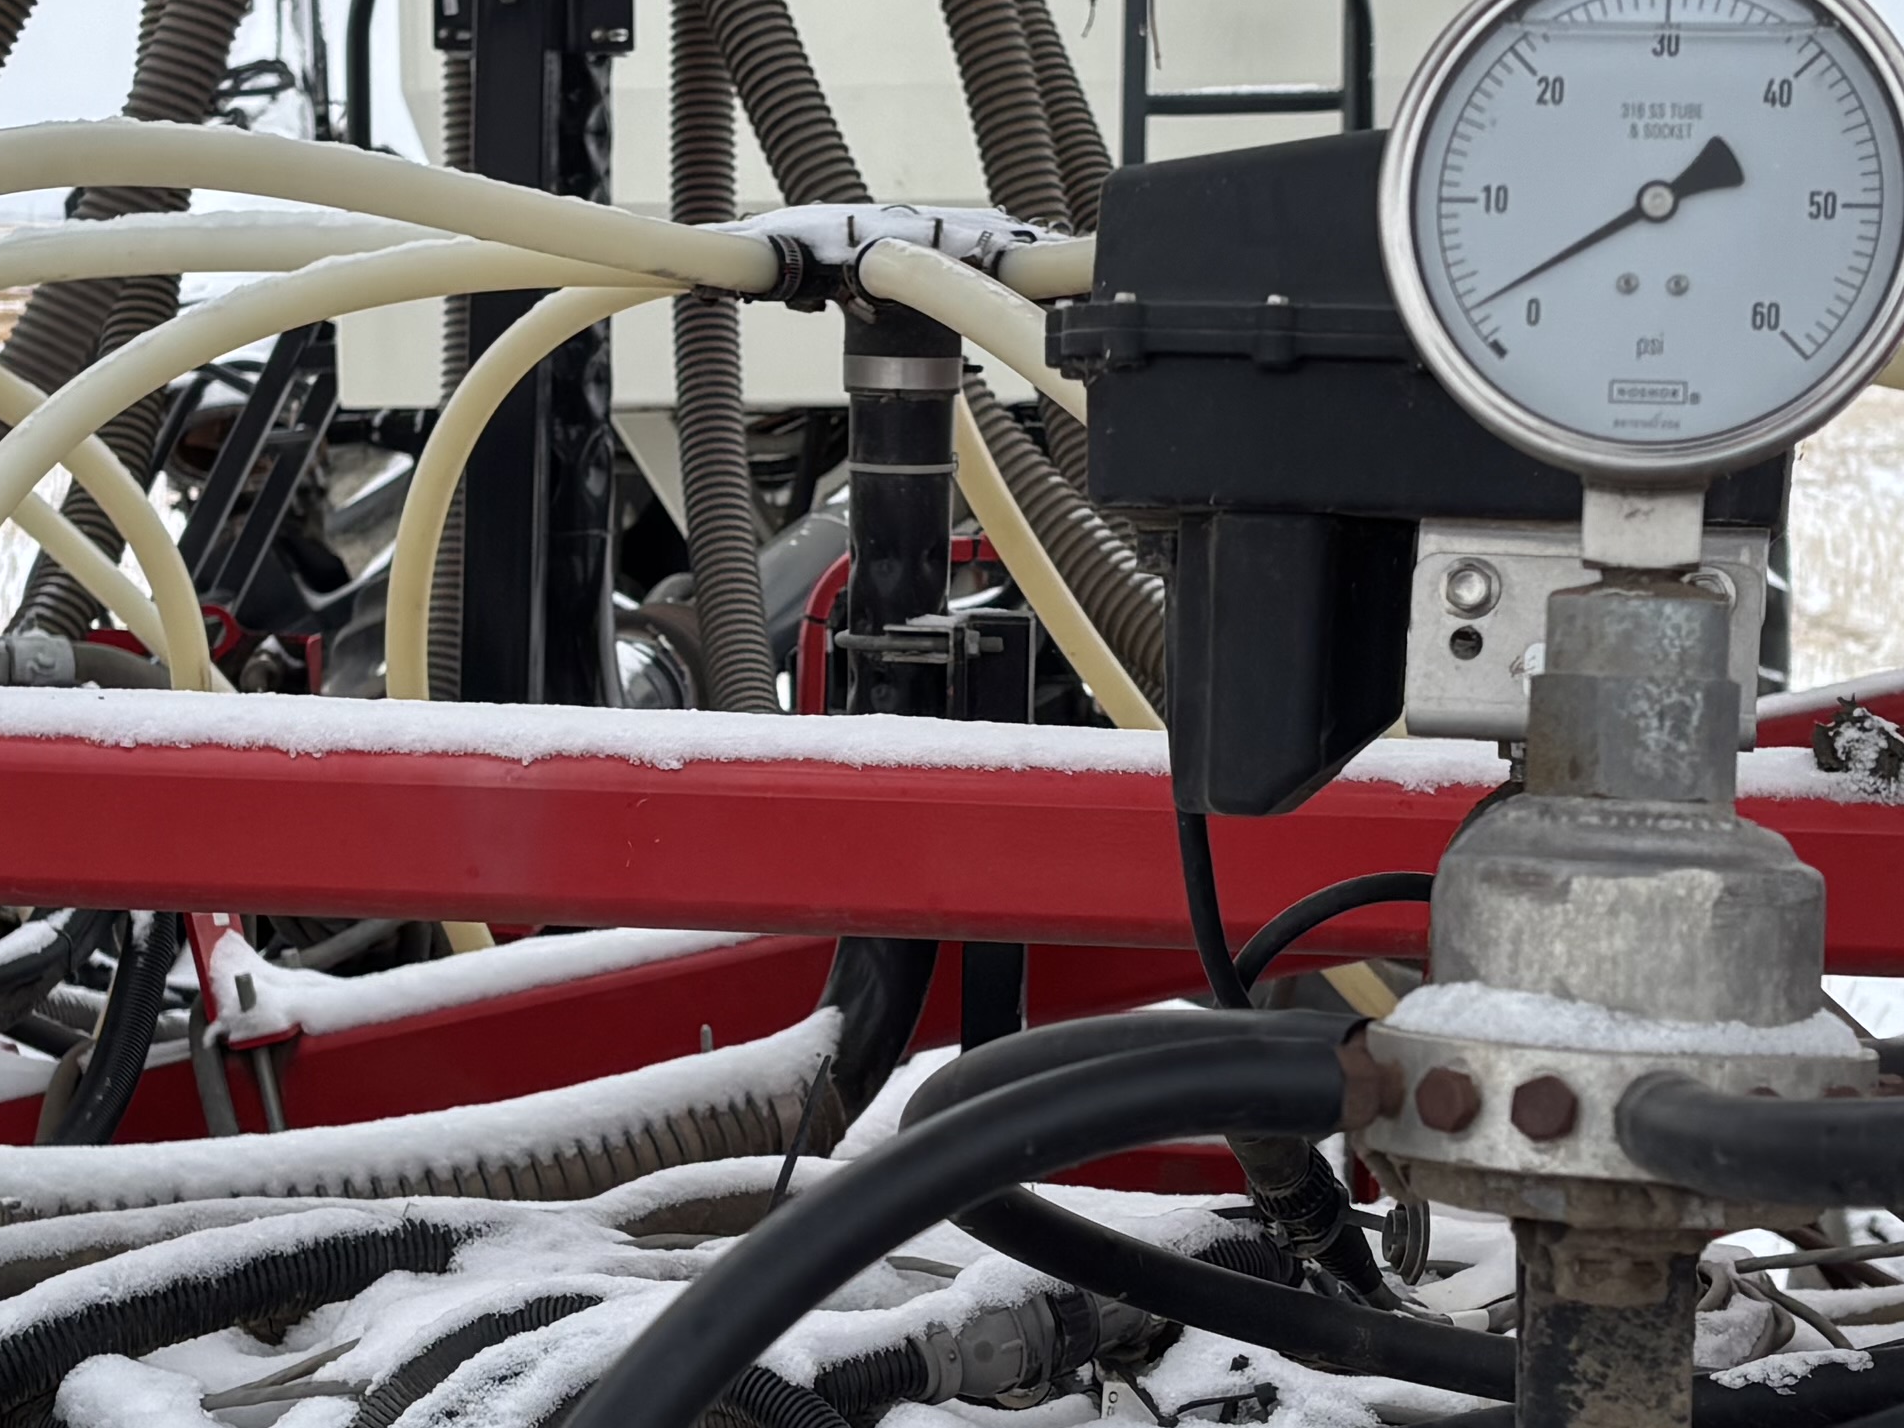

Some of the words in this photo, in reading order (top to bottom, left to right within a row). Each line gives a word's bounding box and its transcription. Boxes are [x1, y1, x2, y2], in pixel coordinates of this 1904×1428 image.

[1652, 34, 1680, 57] 30
[1536, 76, 1564, 106] 20
[1763, 79, 1792, 108] 40
[1671, 103, 1703, 119] TUBE
[1482, 185, 1508, 213] 10
[1808, 191, 1837, 220] 50
[1526, 298, 1540, 325] 0
[1751, 302, 1780, 331] 60
[1636, 331, 1664, 360] psi
